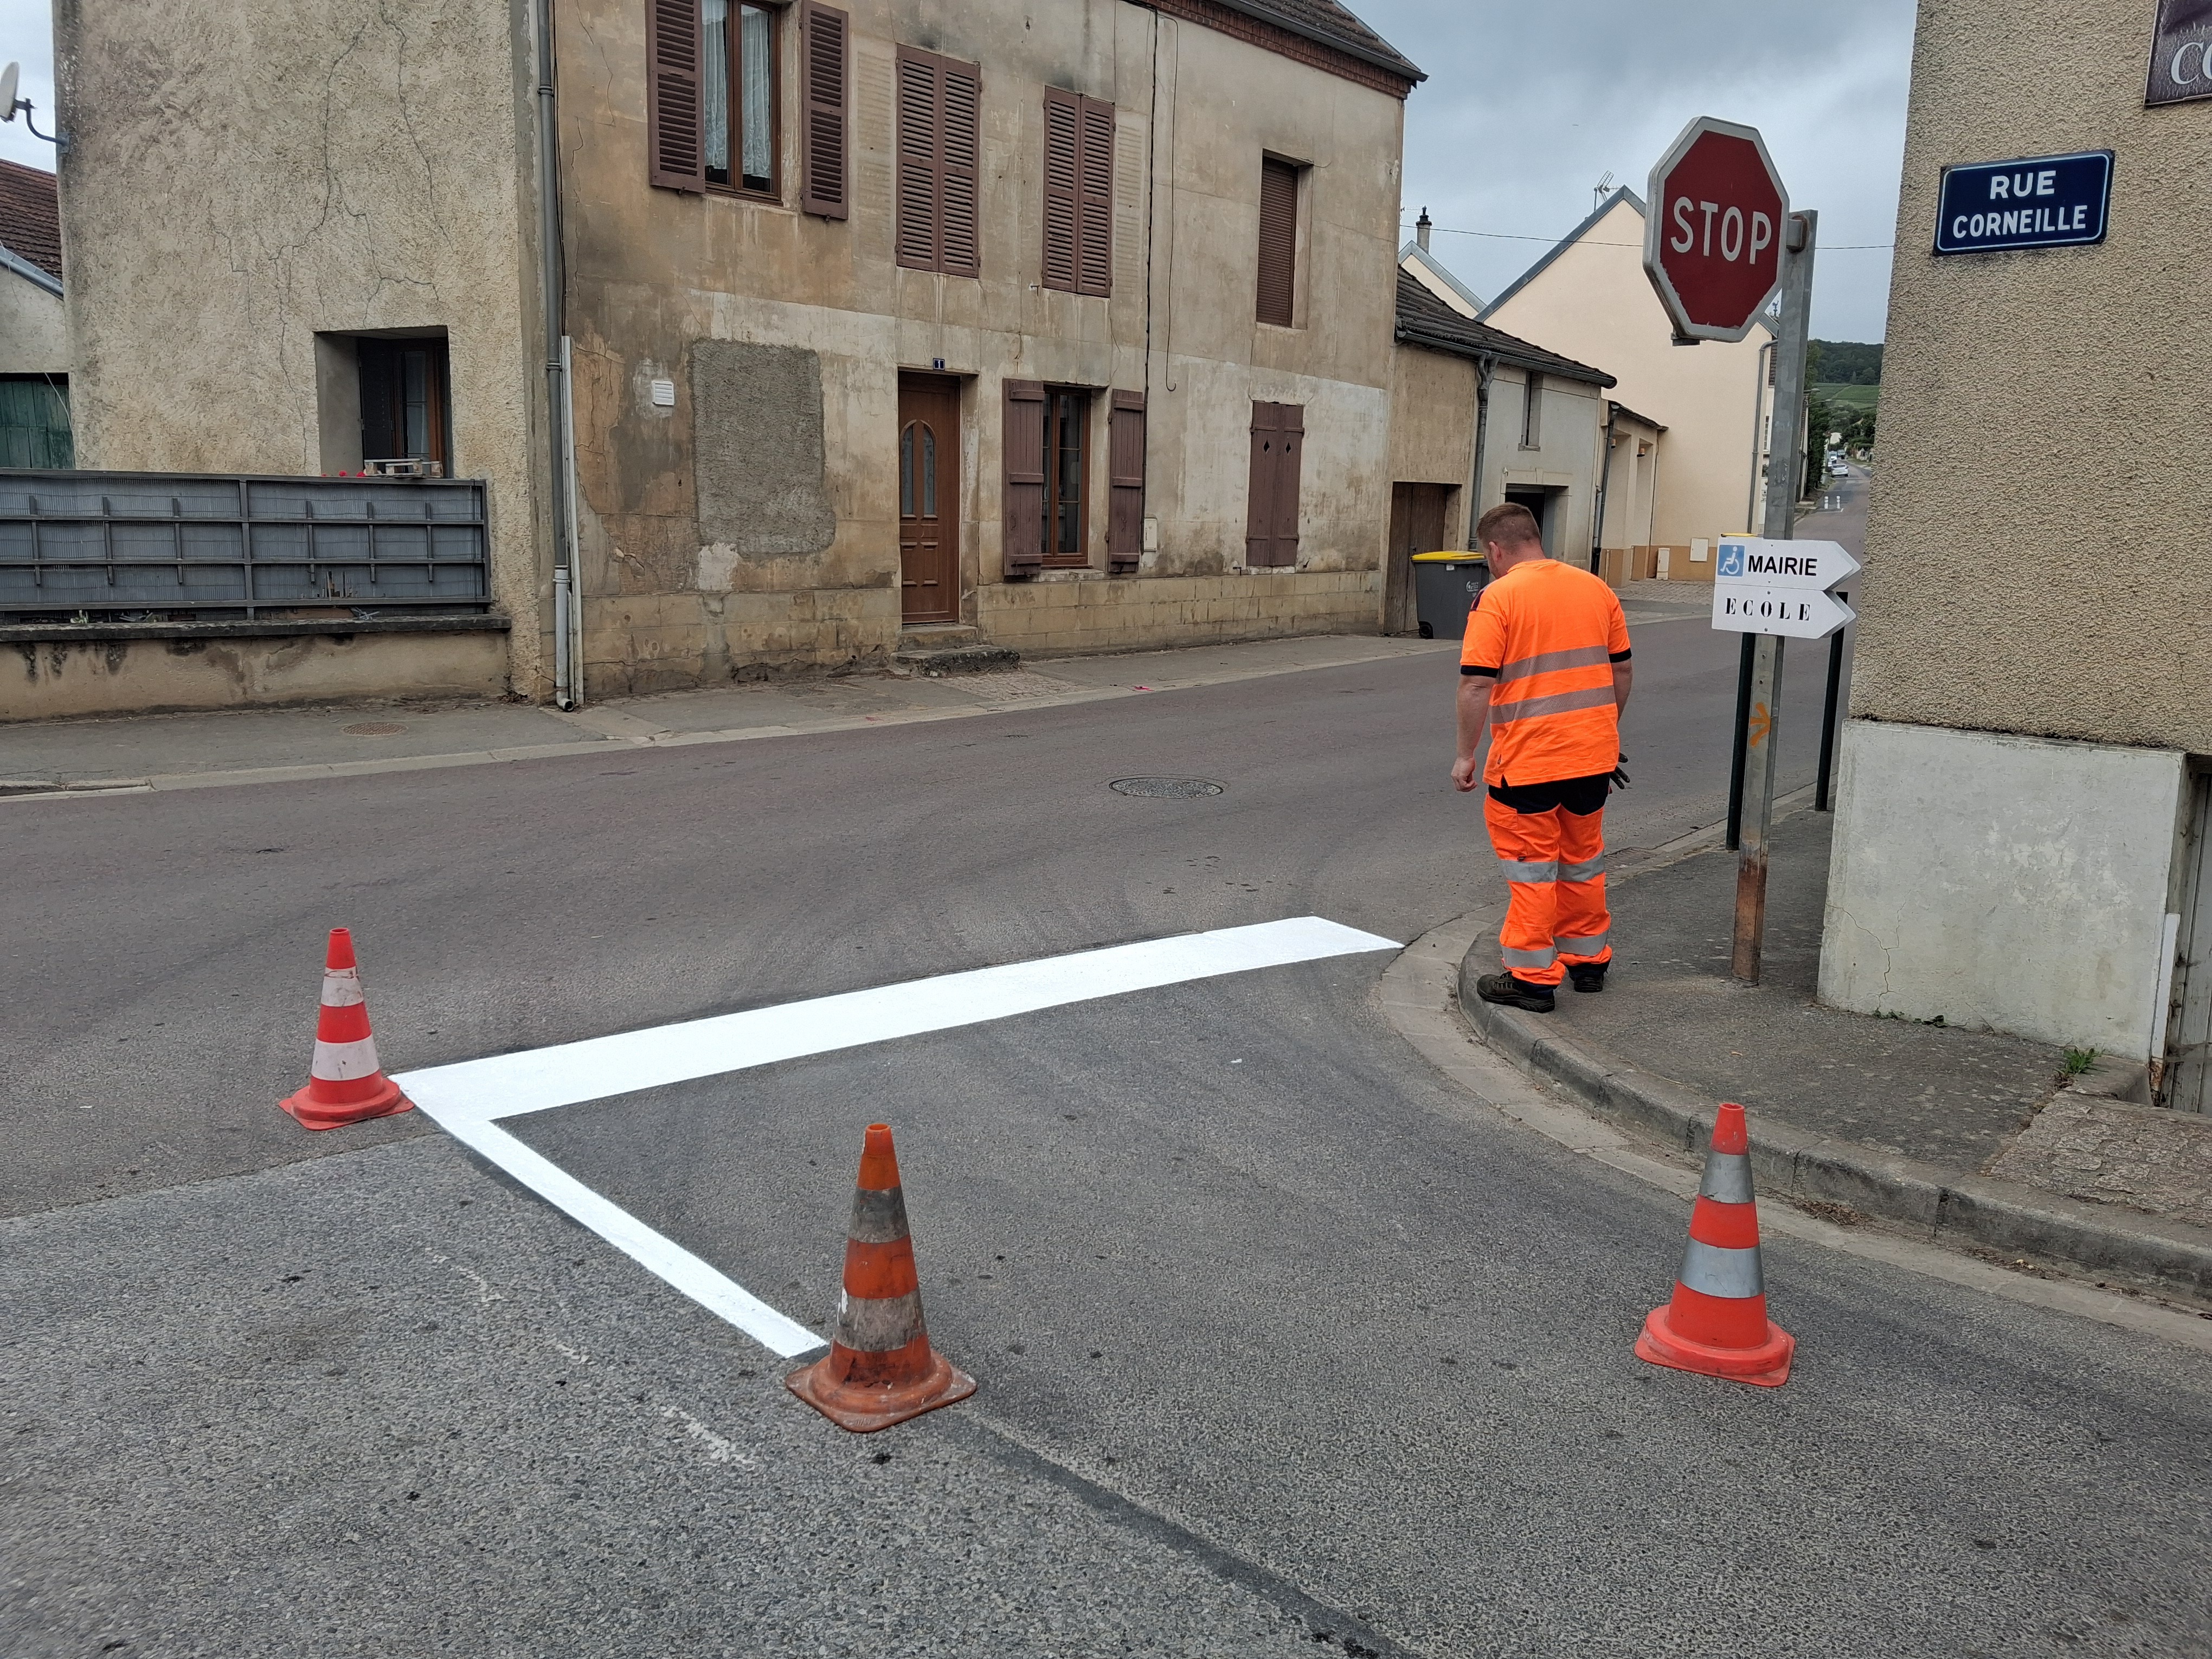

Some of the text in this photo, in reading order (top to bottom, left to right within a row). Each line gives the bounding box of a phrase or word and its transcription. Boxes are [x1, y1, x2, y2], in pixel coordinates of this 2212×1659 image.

[1990, 170, 2056, 200] RUE
[1670, 196, 1772, 265] STOP
[1952, 205, 2088, 239] CORNEILLE
[1748, 555, 1817, 576] MAIRIE
[1725, 597, 1810, 621] ECOLE
